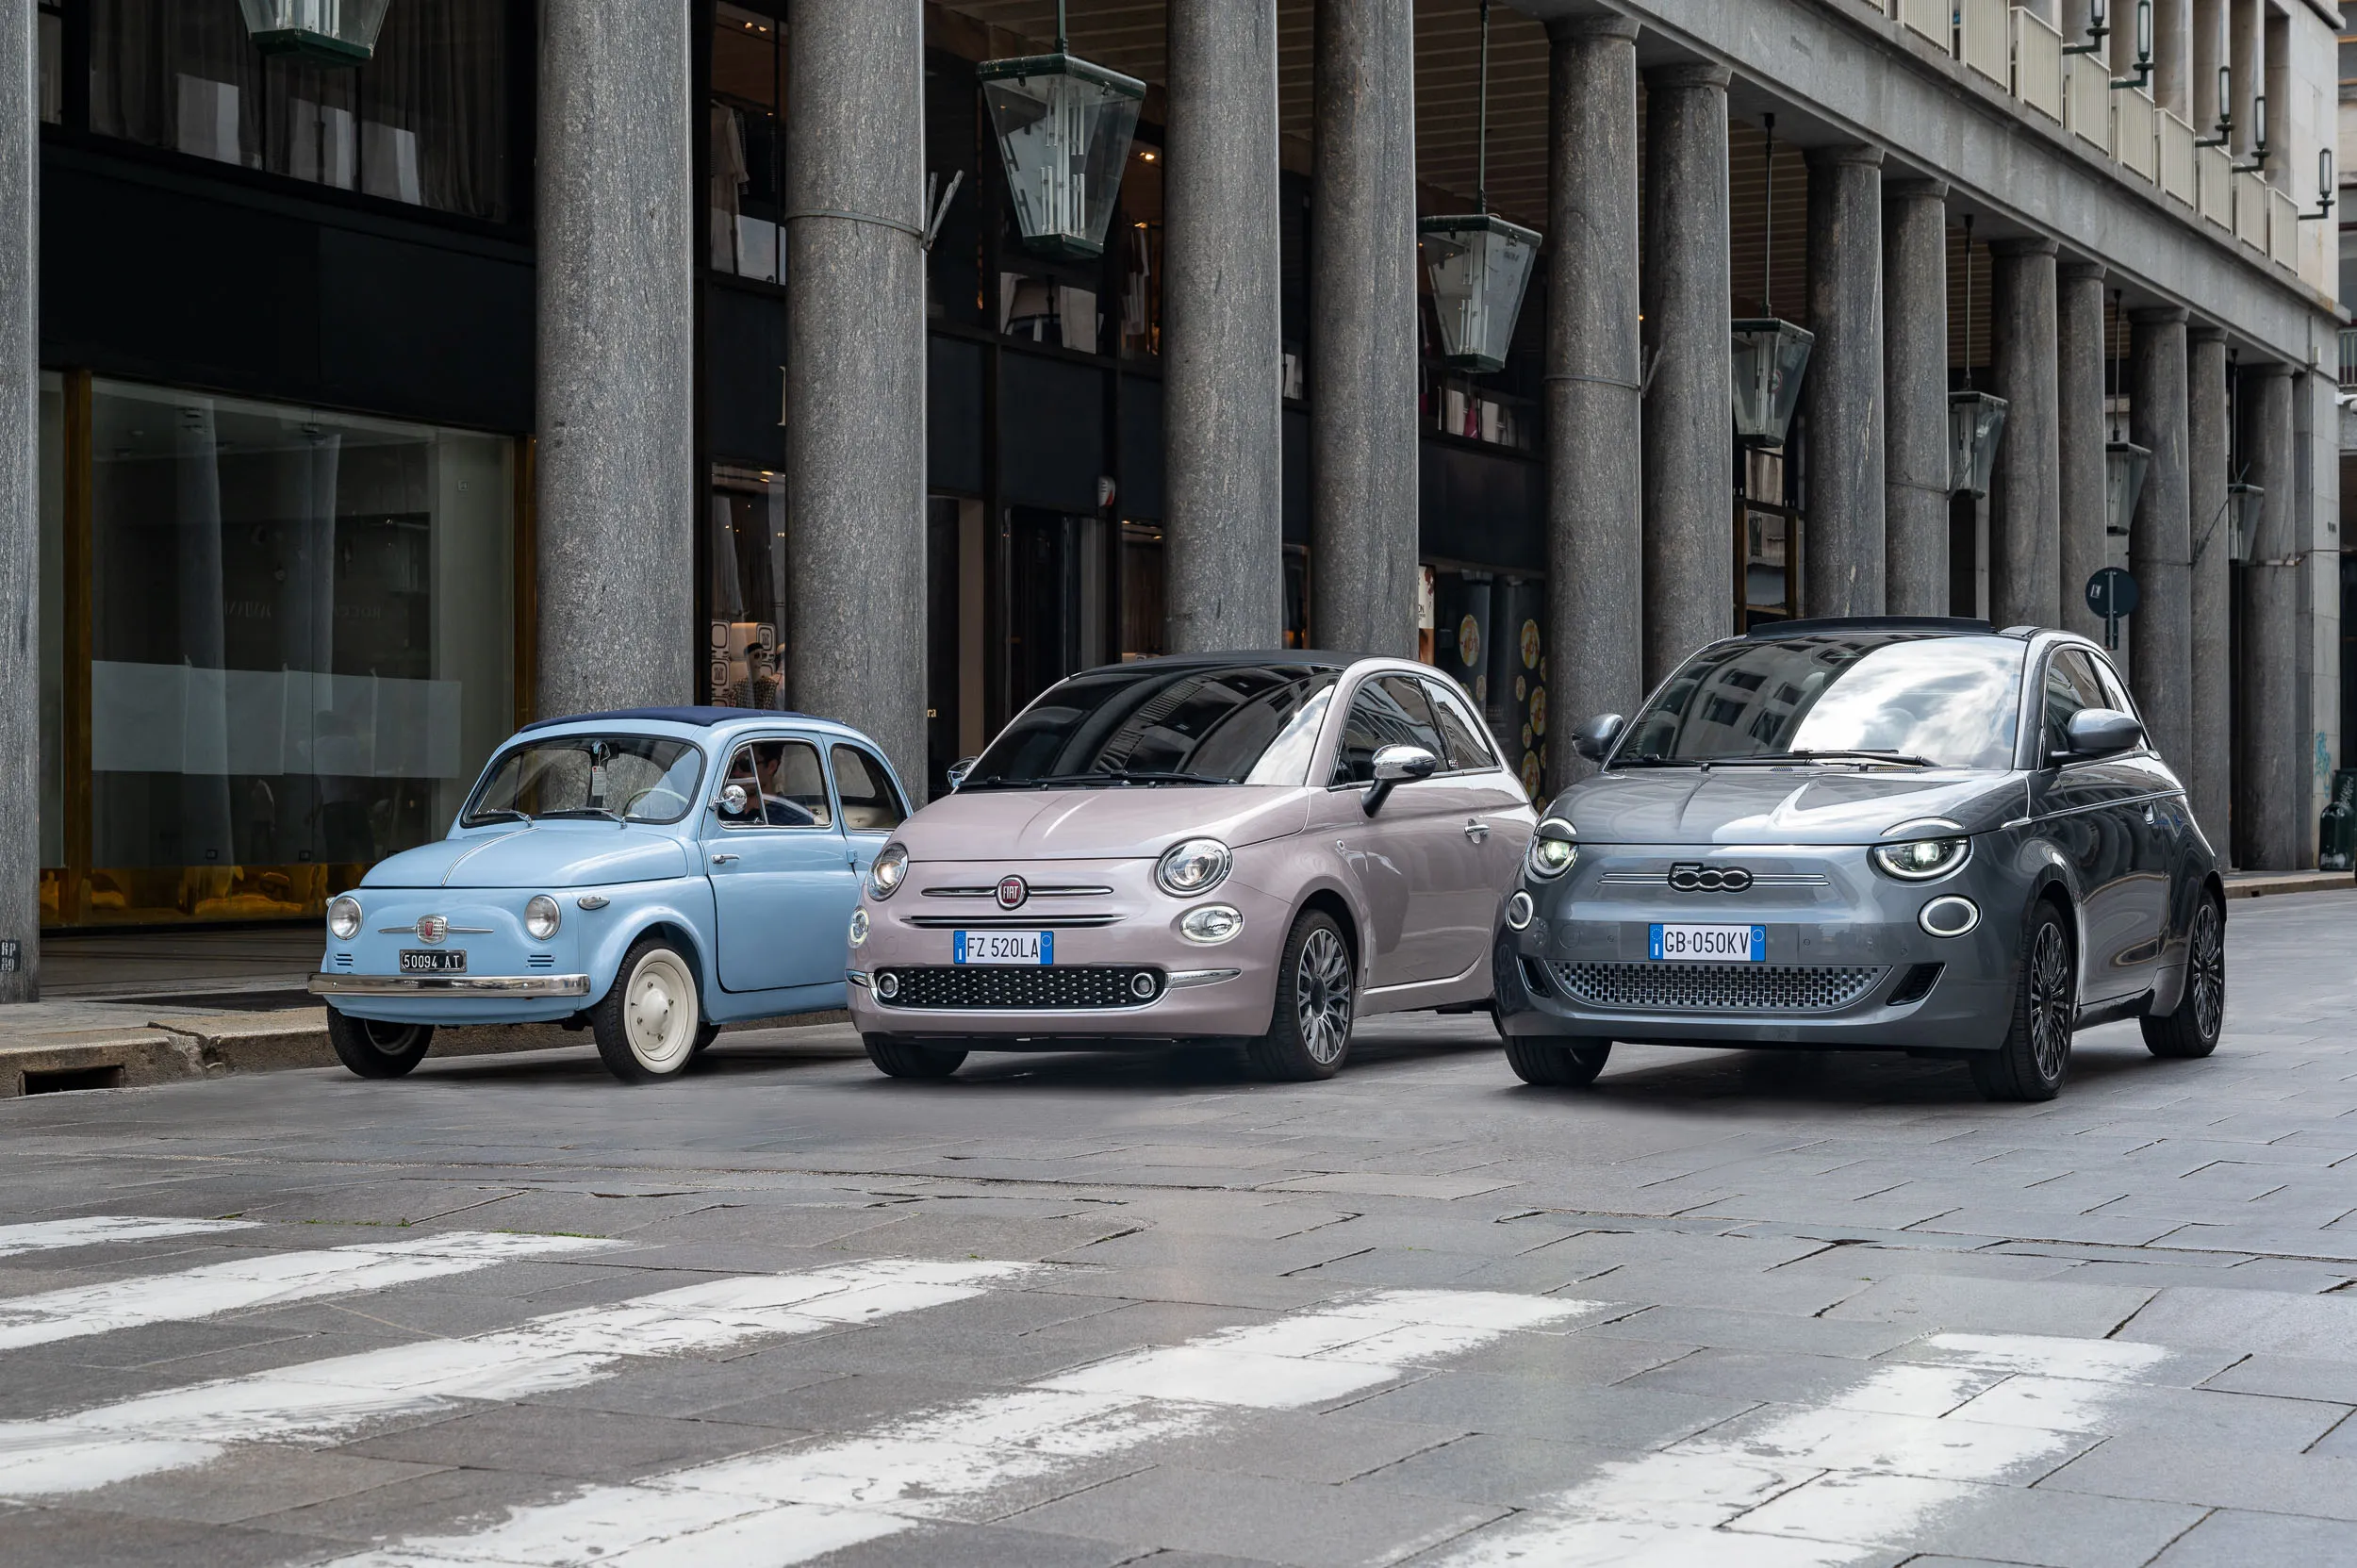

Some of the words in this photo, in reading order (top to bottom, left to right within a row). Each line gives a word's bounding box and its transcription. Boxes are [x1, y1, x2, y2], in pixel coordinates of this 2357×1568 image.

[1671, 865, 1751, 890] 500
[1003, 885, 1019, 900] FIAT
[967, 937, 985, 957] FZ
[991, 937, 1039, 958] 520LA
[404, 954, 437, 968] 50094
[444, 955, 460, 968] AT
